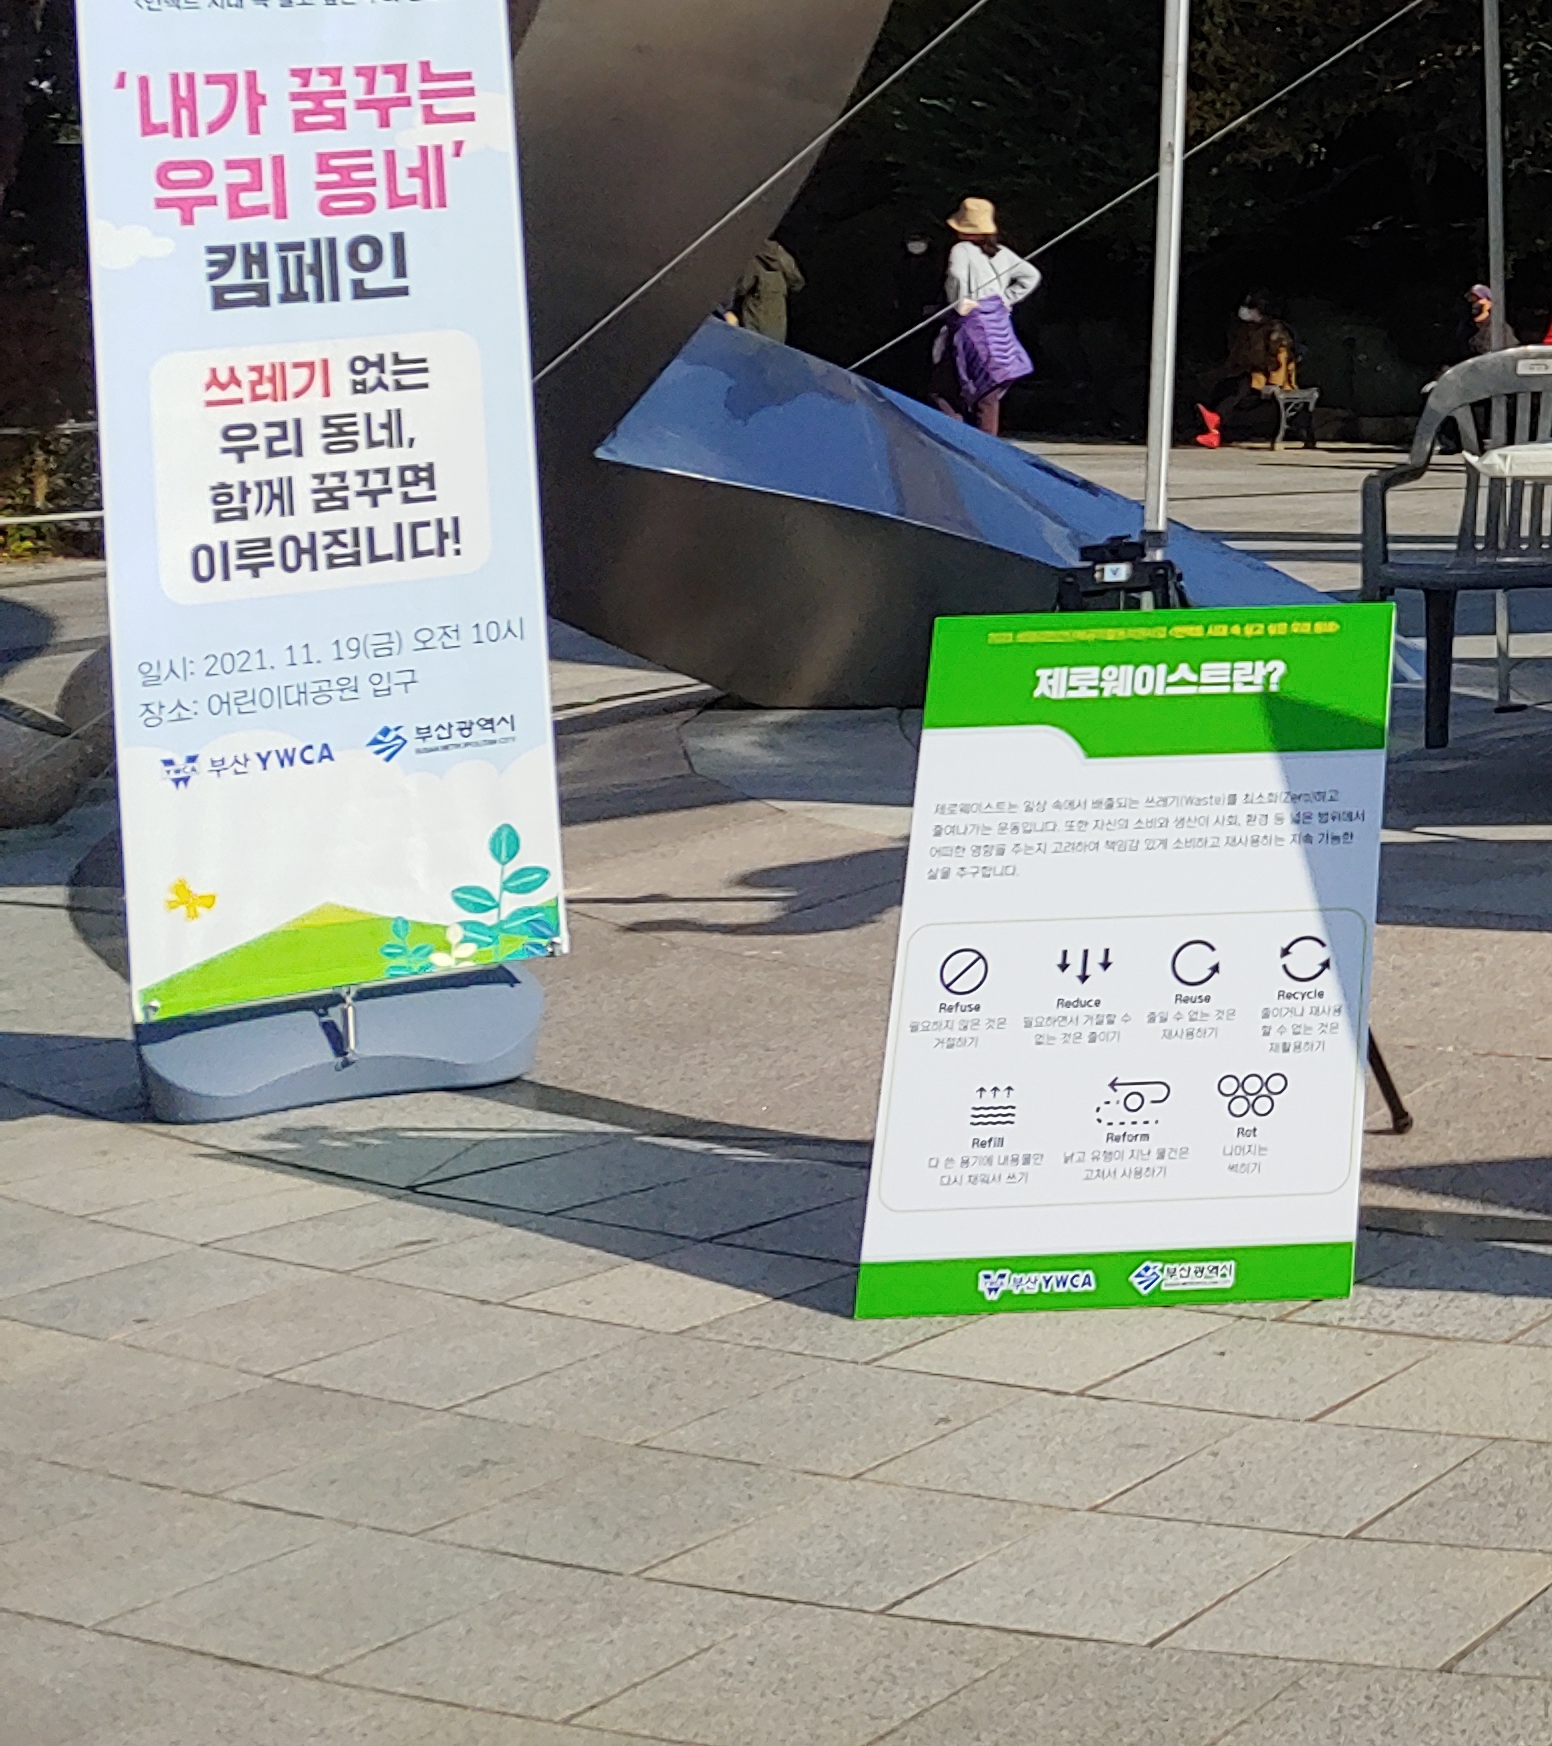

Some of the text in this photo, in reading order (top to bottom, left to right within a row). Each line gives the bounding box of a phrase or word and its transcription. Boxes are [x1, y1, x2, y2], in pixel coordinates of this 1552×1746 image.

[289, 60, 477, 133] 꿈꾸는
[154, 154, 290, 226] 우리
[205, 232, 411, 311] 캠페인
[204, 351, 430, 408] 쓰레기 없는
[220, 408, 416, 463] 우리 동네,
[209, 461, 437, 524] 함께 꿈꾸면
[191, 515, 461, 583] 이루어집니다!
[137, 616, 526, 687] 일시: 2021. 11. 19(금) 오전 10시
[138, 668, 418, 728] 장소: 어린이대공원 입구
[1033, 660, 1287, 700] 제로웨이스트란?
[414, 714, 516, 743] 부산광역시
[207, 743, 335, 776] 부산 YWCA
[939, 1001, 981, 1014] Refuse
[1057, 996, 1101, 1010] Reduce
[1174, 992, 1212, 1005] Reuse
[1277, 988, 1325, 1003] Recycle
[971, 1136, 1004, 1149] Refill
[1106, 1131, 1150, 1144] Reform
[1236, 1126, 1258, 1139] Rot
[1042, 1273, 1093, 1289] YWCA
